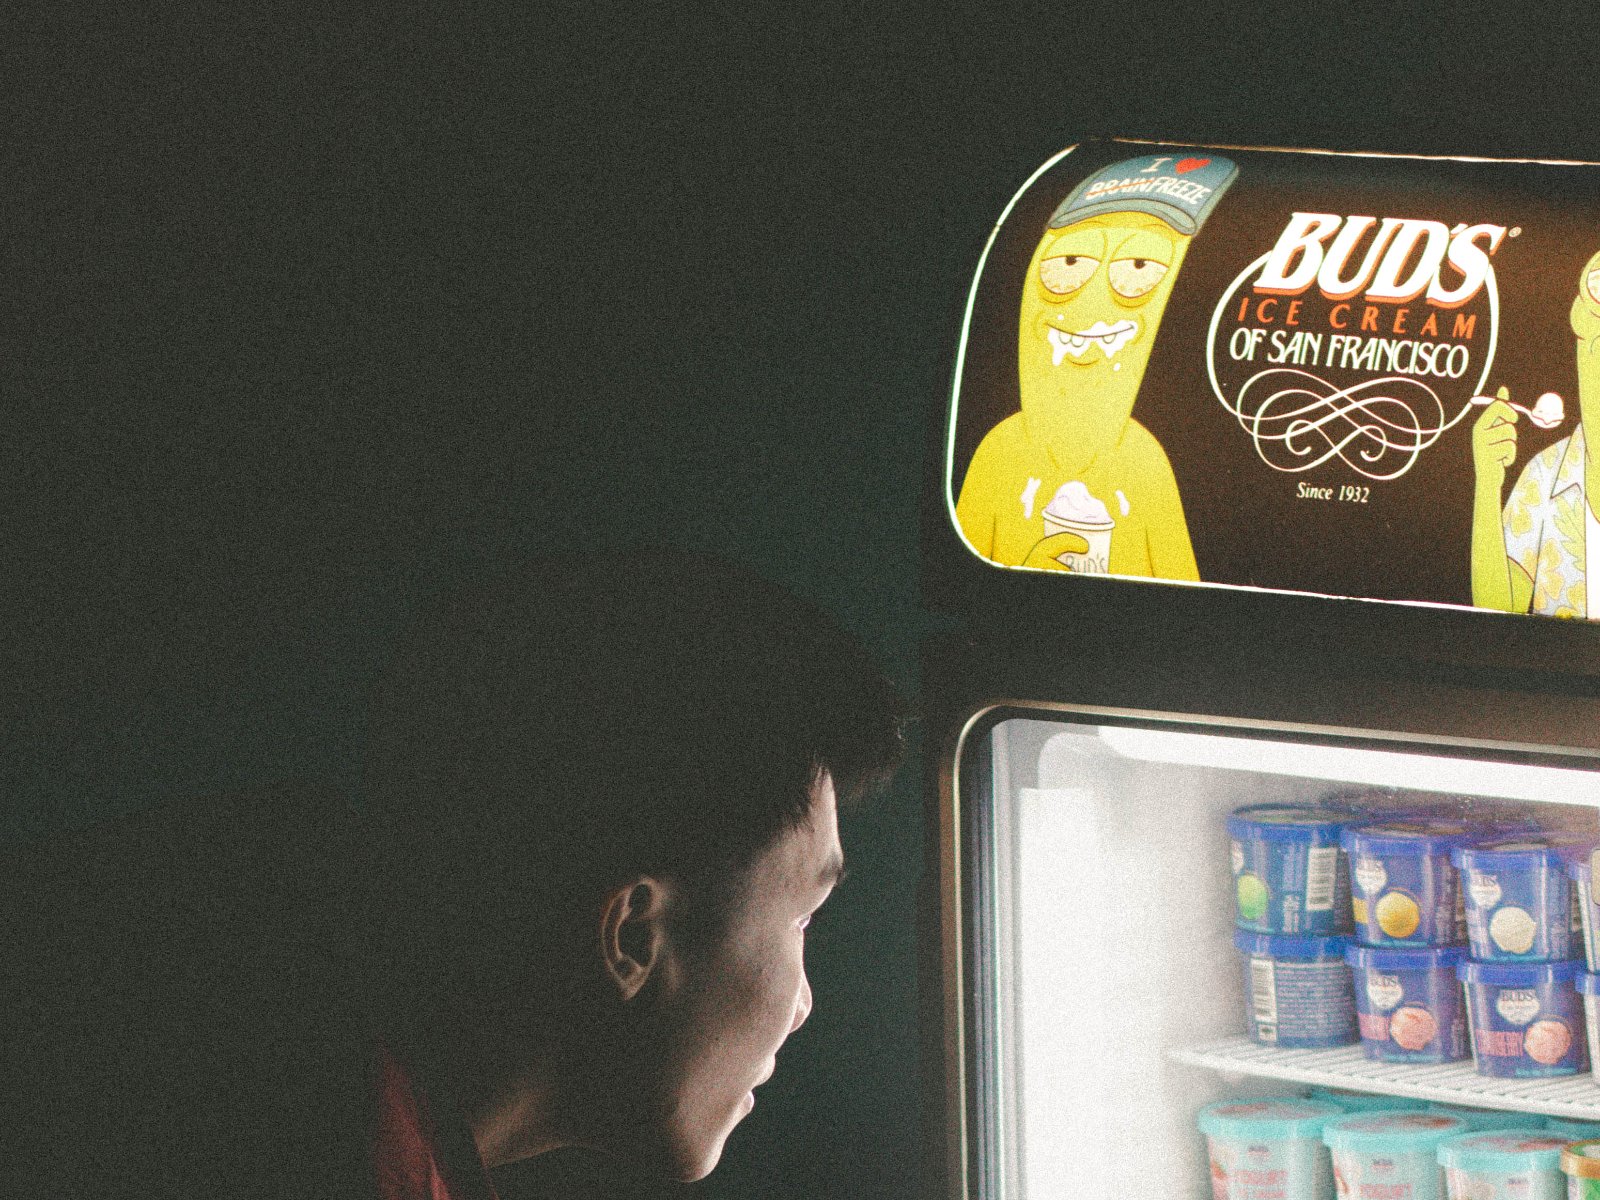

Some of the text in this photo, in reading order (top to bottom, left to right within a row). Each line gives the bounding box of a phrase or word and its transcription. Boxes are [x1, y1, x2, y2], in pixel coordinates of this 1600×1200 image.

[1140, 157, 1173, 173] I
[1253, 212, 1507, 309] BUD'S
[1238, 297, 1477, 339] ICE CREAM
[1230, 327, 1469, 378] OF SAN FRANCISCO
[1296, 482, 1370, 503] Since 1932
